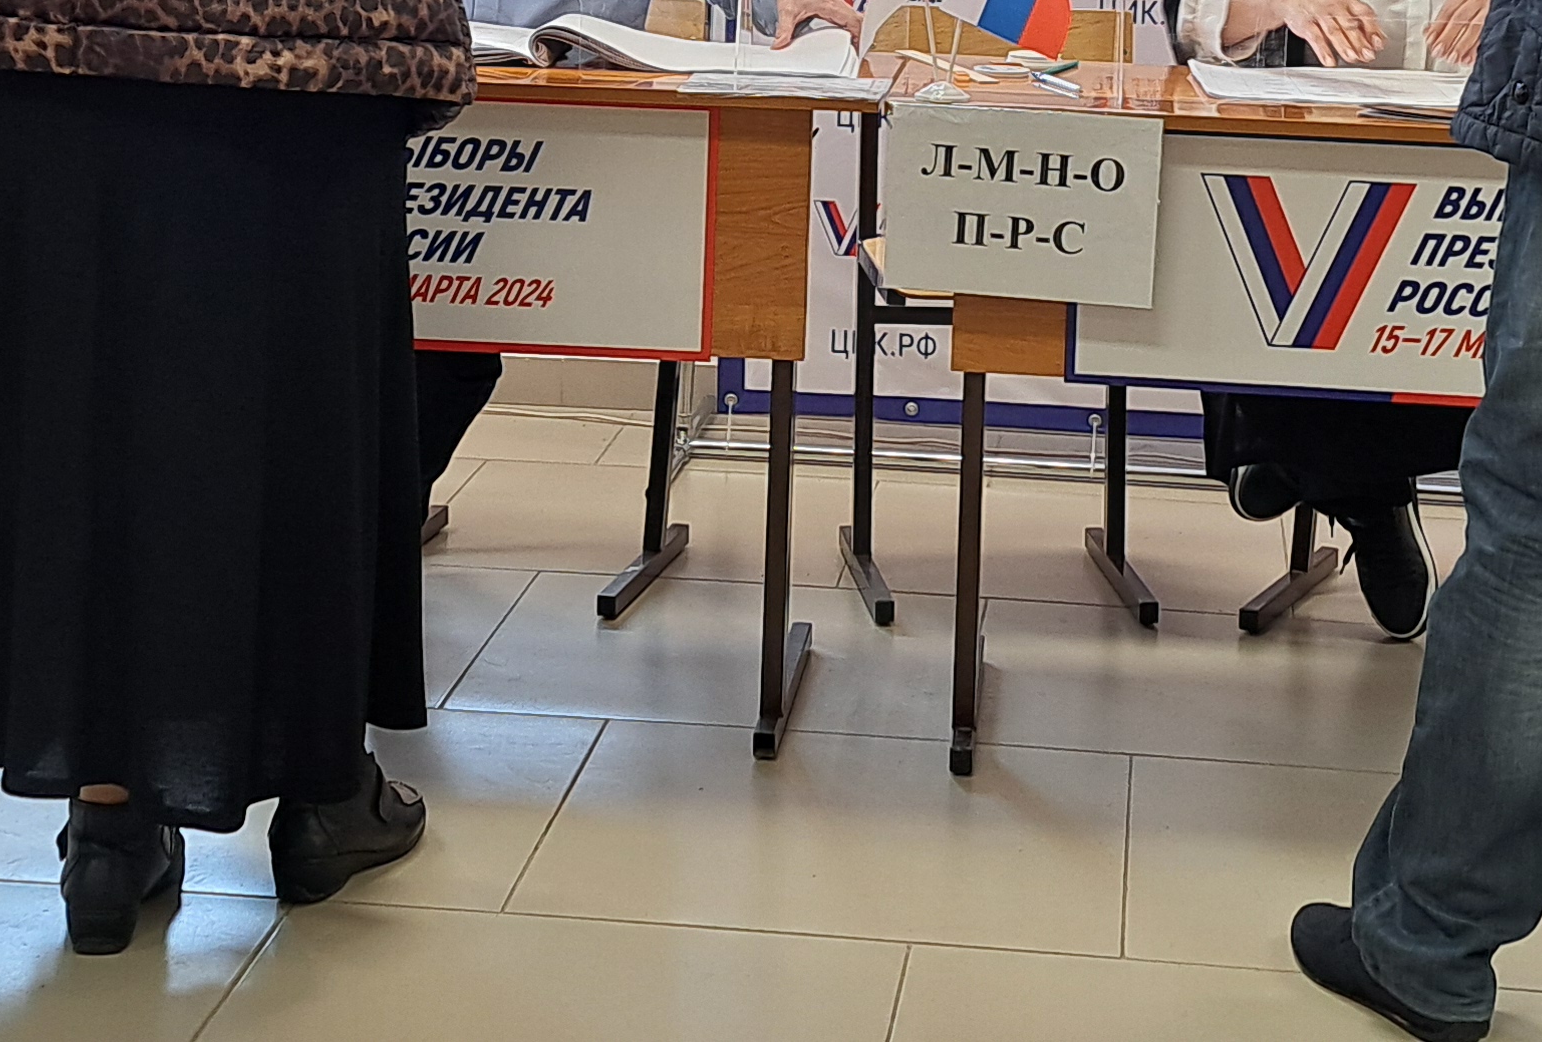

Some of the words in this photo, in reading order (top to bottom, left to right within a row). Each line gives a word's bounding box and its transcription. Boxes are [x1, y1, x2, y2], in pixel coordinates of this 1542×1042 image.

[406, 136, 544, 173] ЫБОРЫ
[920, 142, 1125, 192] Л-М-Н-О
[406, 182, 592, 223] ЕЗИДЕНТА
[407, 228, 486, 264] СИИ
[952, 211, 1086, 255] П-Р-С
[485, 277, 554, 308] 2024
[1386, 279, 1492, 316] РОСС
